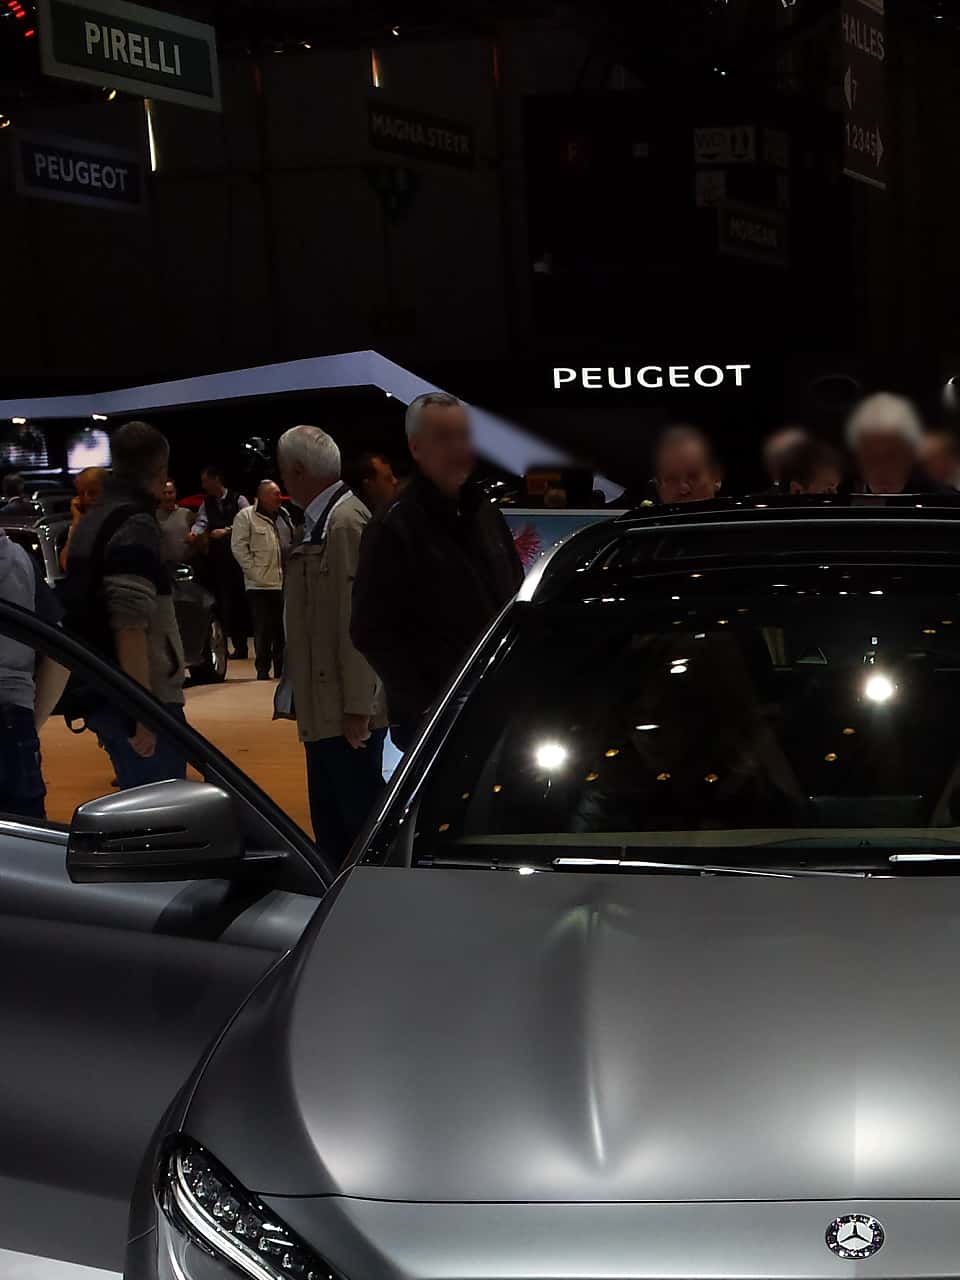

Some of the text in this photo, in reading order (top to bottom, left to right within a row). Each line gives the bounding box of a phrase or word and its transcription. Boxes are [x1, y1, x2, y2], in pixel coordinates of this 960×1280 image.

[84, 20, 183, 77] PIRELLI
[841, 13, 886, 62] HALLES
[33, 152, 129, 192] PEUGEOT
[553, 364, 751, 389] PEUGEOT
